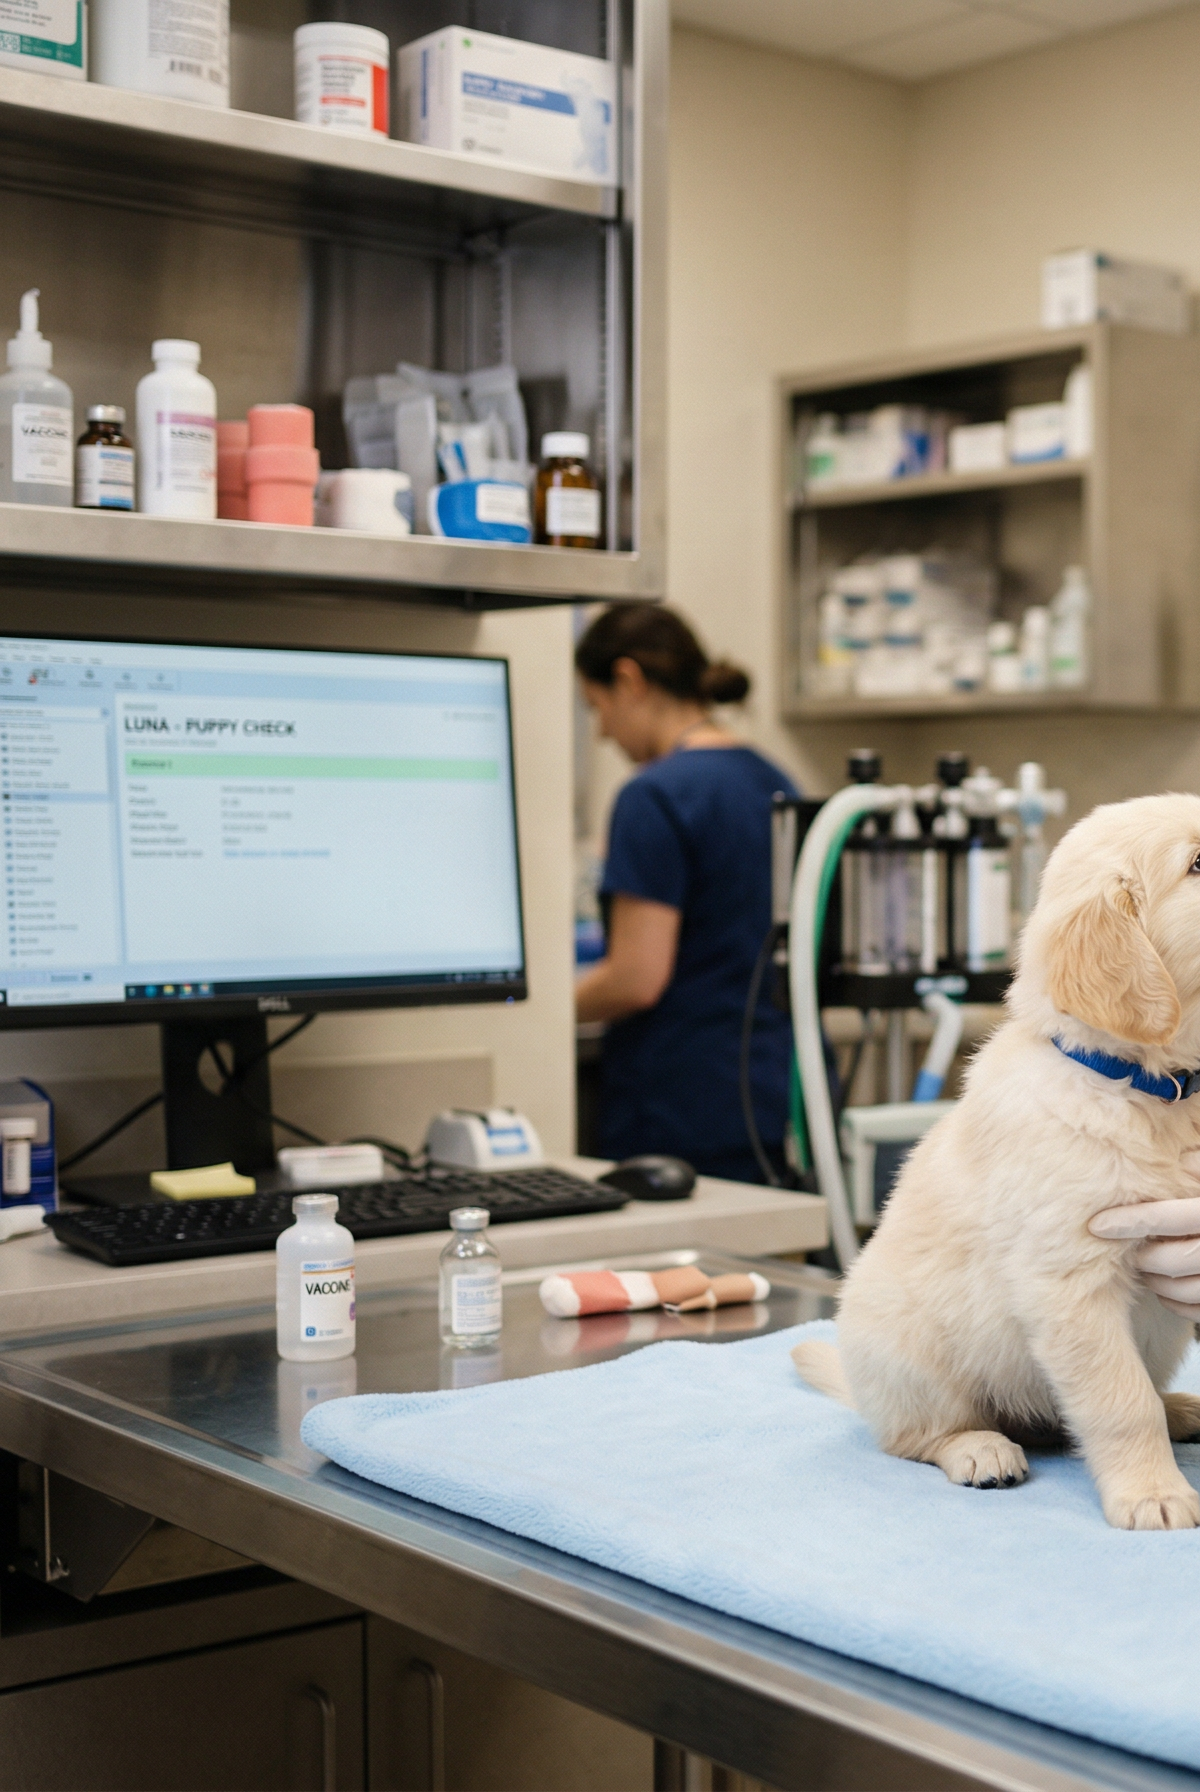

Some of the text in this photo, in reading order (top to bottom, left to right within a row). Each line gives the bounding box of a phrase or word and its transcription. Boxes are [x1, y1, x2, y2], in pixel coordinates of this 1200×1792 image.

[124, 716, 170, 733] LUNA
[185, 718, 239, 735] PUPPY
[243, 719, 297, 737] CHECK
